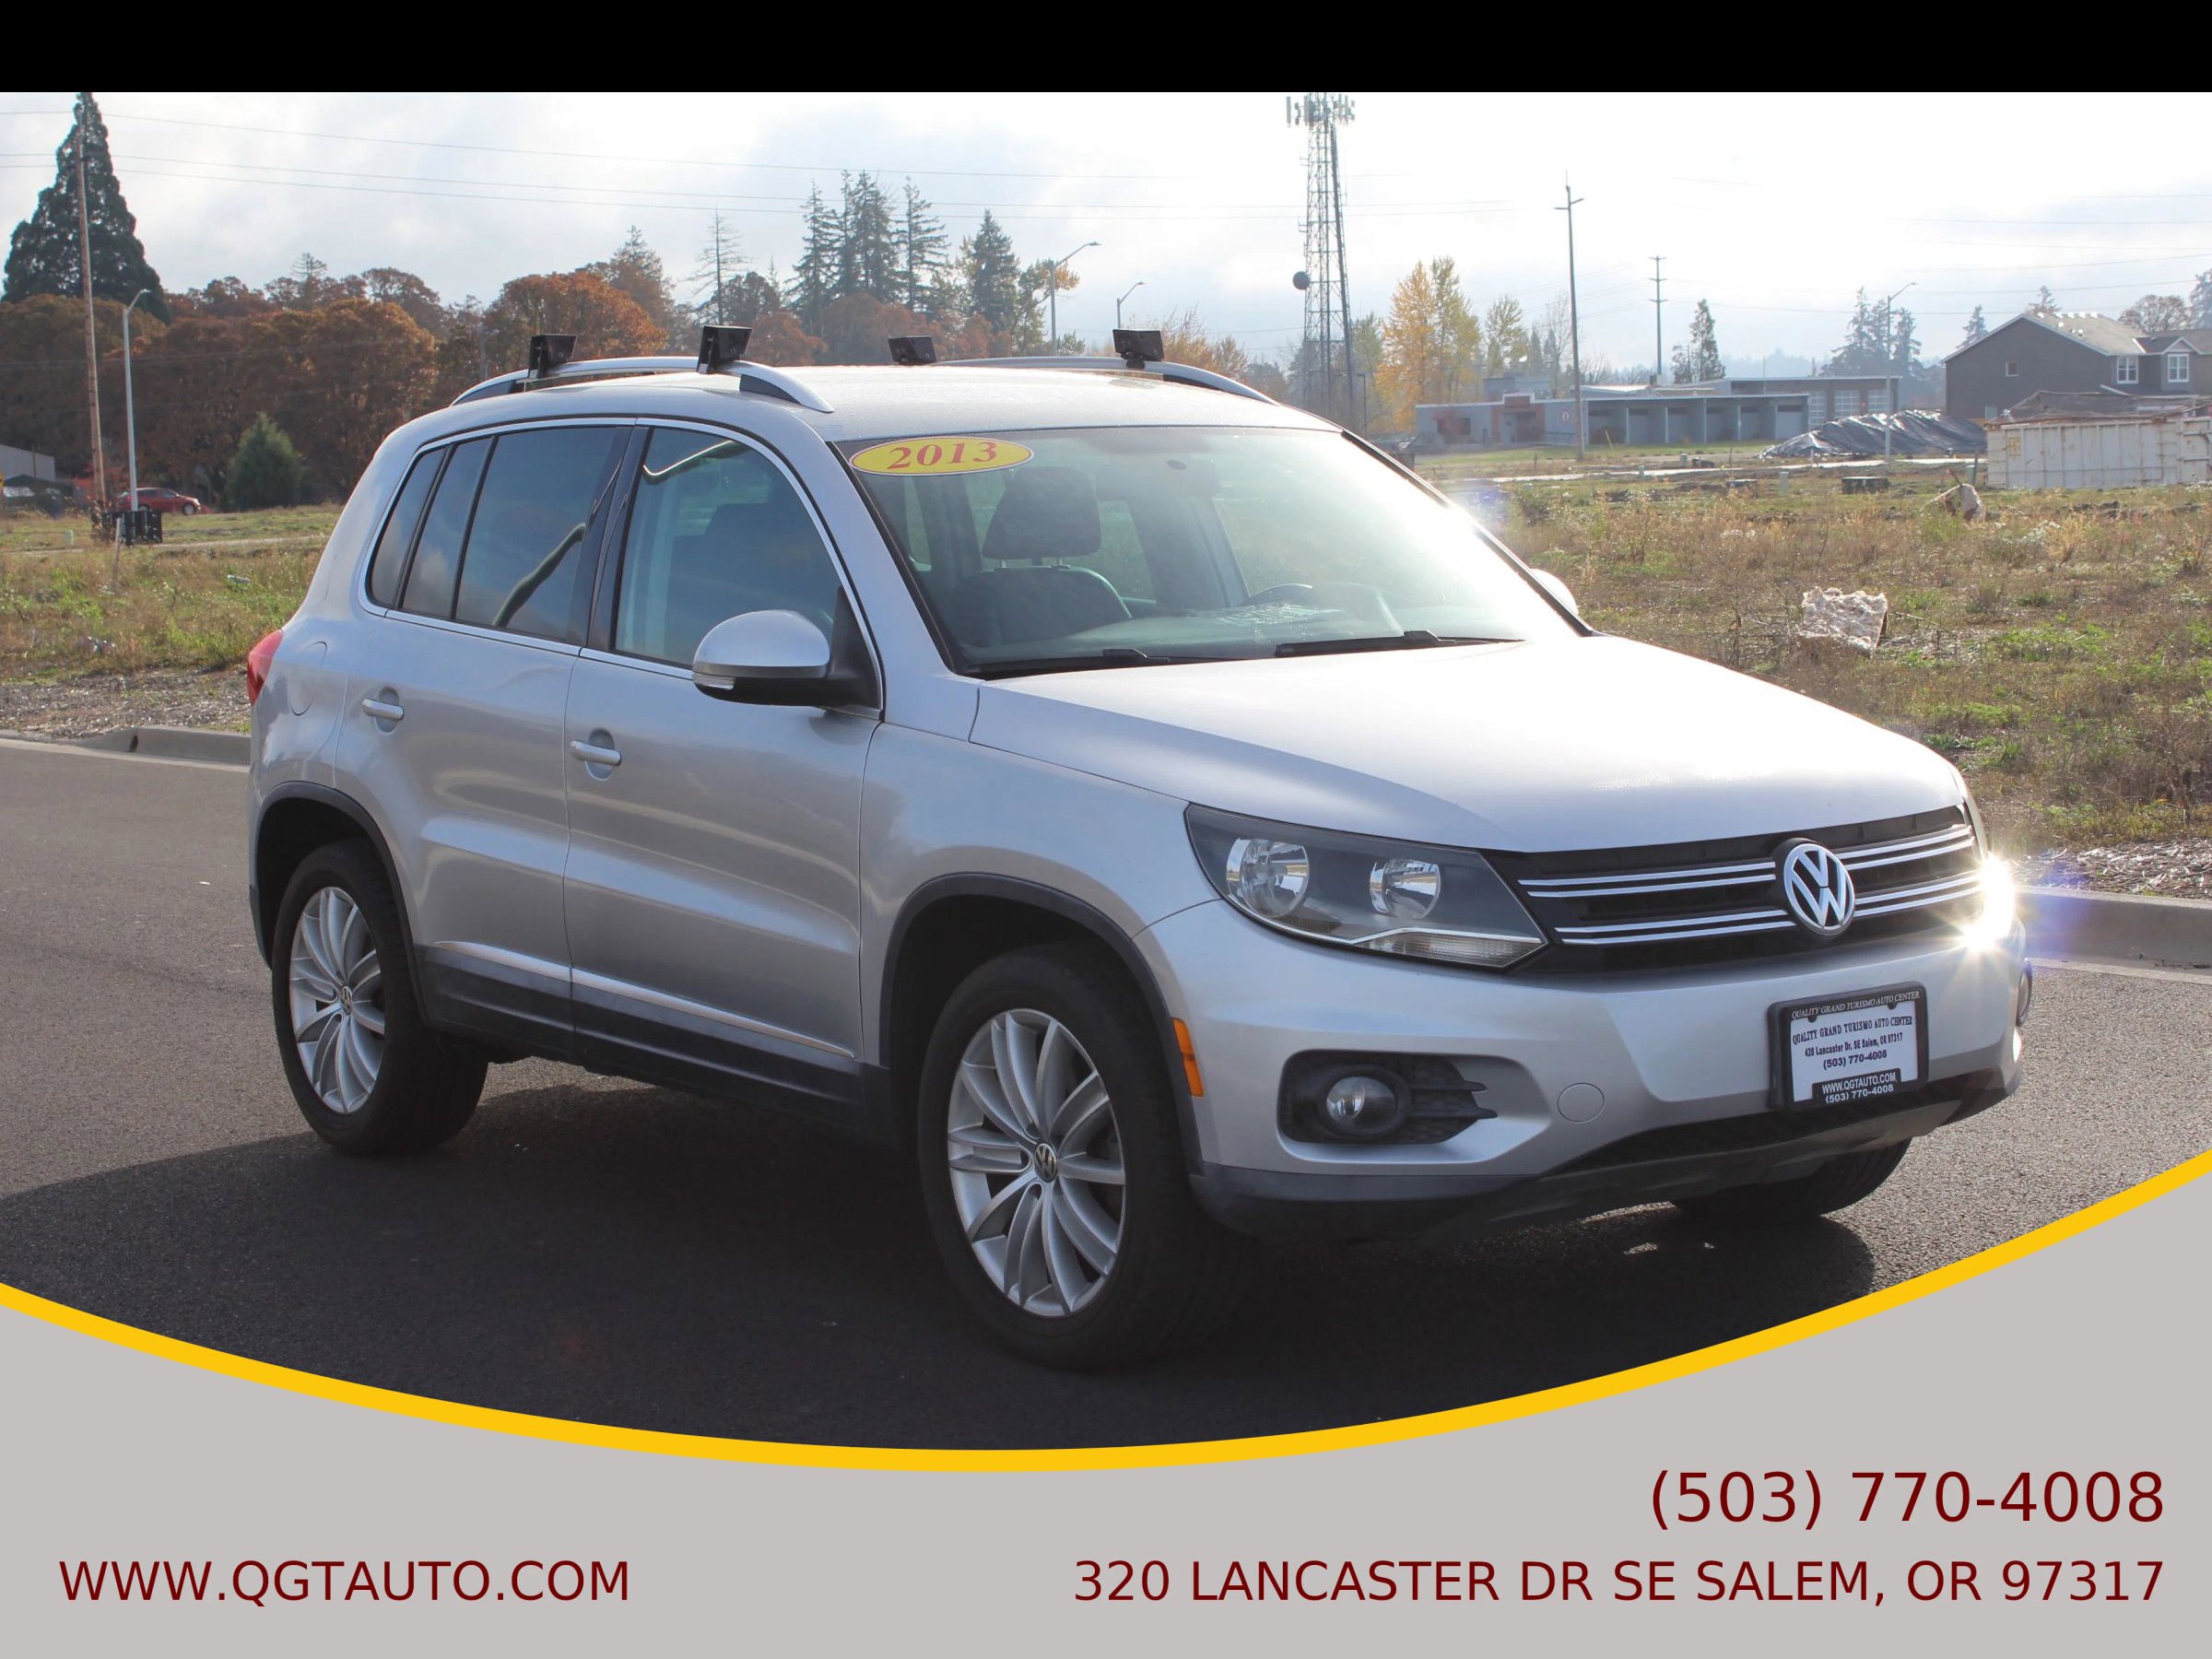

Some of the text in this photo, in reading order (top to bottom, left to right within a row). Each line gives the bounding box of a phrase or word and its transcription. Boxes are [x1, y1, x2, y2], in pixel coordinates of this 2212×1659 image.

[887, 441, 997, 470] 2013
[1792, 991, 1920, 1018] QUALITY GRAND TURISMO AUTO CENTER
[1793, 1016, 1912, 1044] QUALITY GRAND TURISMO AUTO CENTER
[1816, 1043, 1843, 1054] Lancaster
[1853, 1040, 1860, 1049] SE
[1862, 1037, 1879, 1048] Salem,
[1880, 1035, 1887, 1044] OR
[1888, 1032, 1902, 1043] 97317
[1823, 1050, 1887, 1070] (503) 770-4008
[1822, 1072, 1896, 1094] WWW.QGTAUTO.COM
[1826, 1084, 1894, 1103] (503) 770-4008
